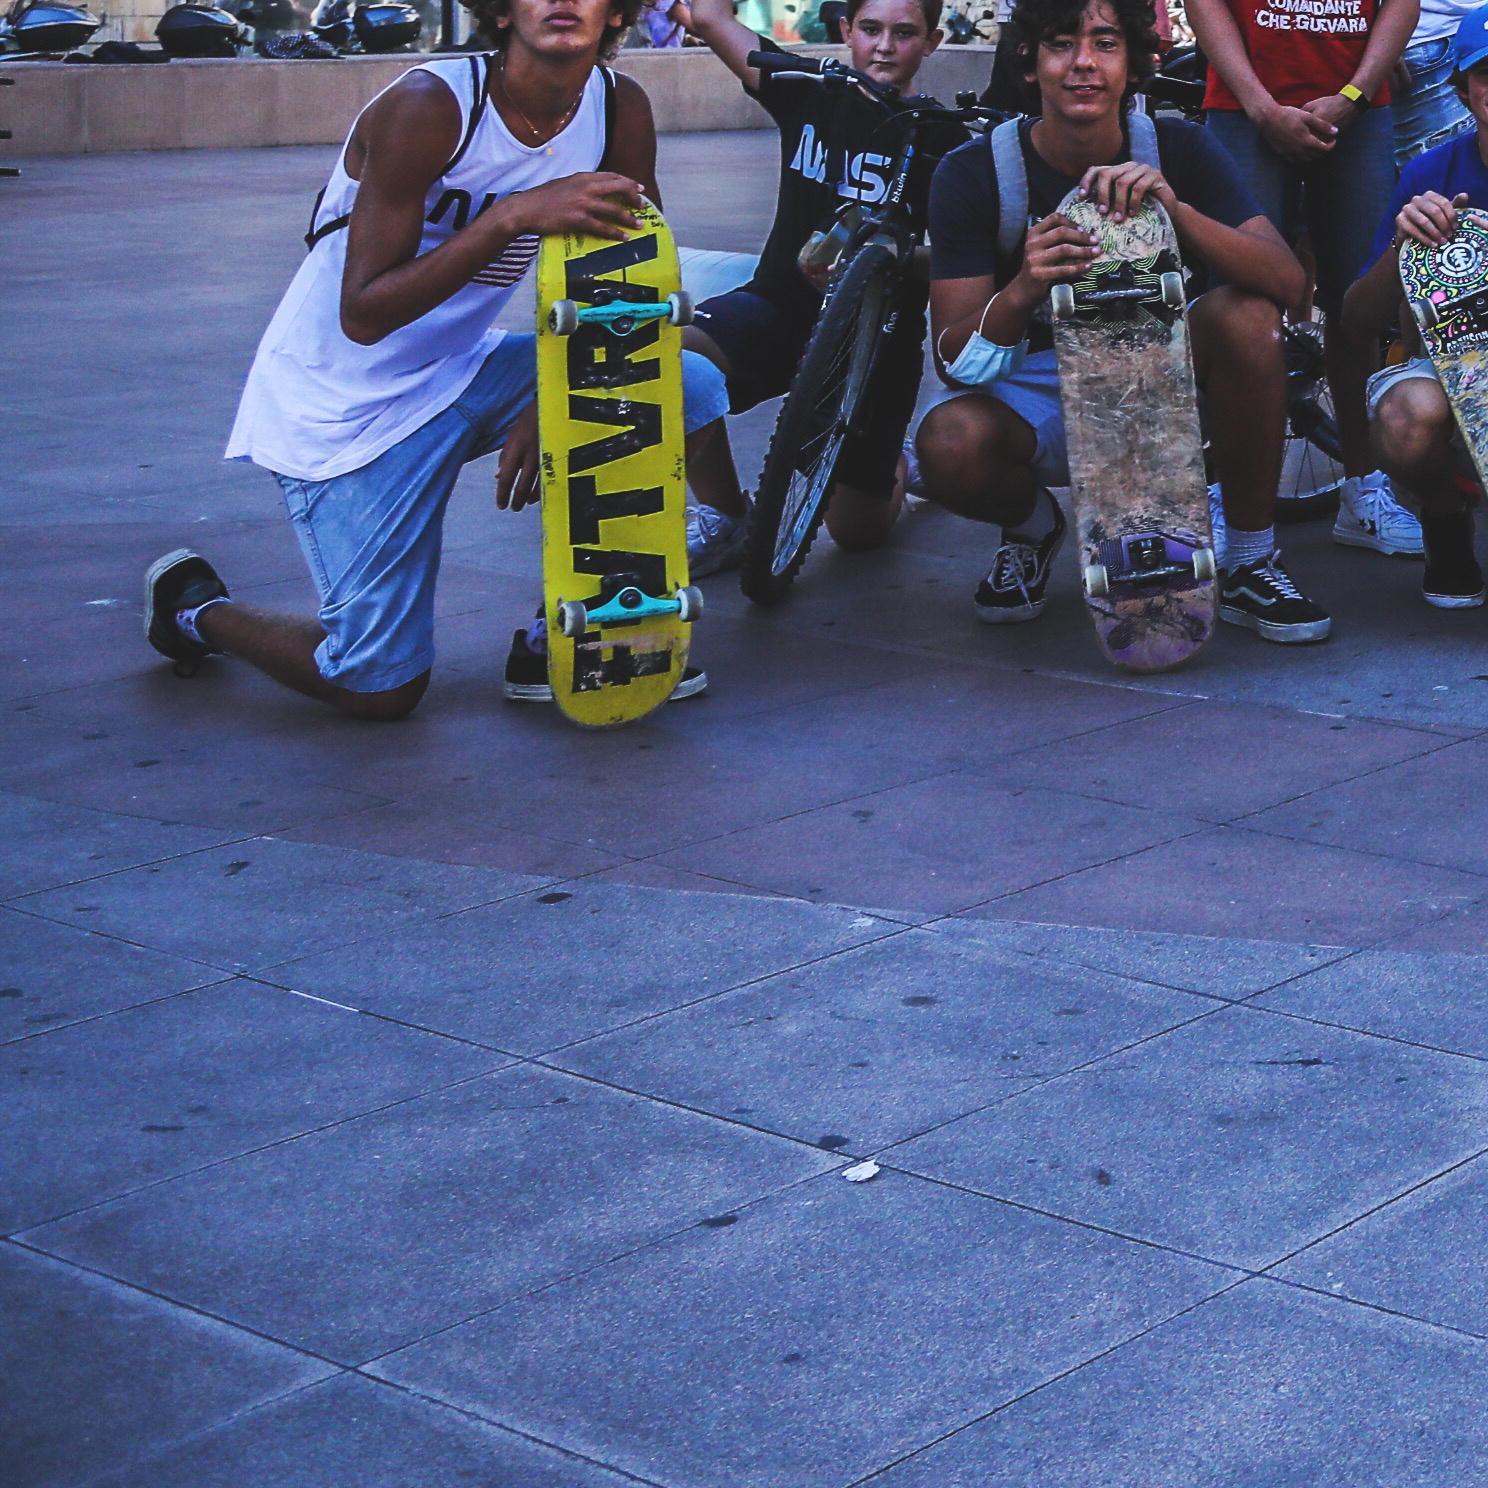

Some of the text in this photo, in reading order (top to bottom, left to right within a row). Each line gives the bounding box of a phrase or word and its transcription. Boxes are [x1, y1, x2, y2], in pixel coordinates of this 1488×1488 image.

[1256, 9, 1368, 33] CHE GUEVARA
[890, 172, 907, 204] btwin
